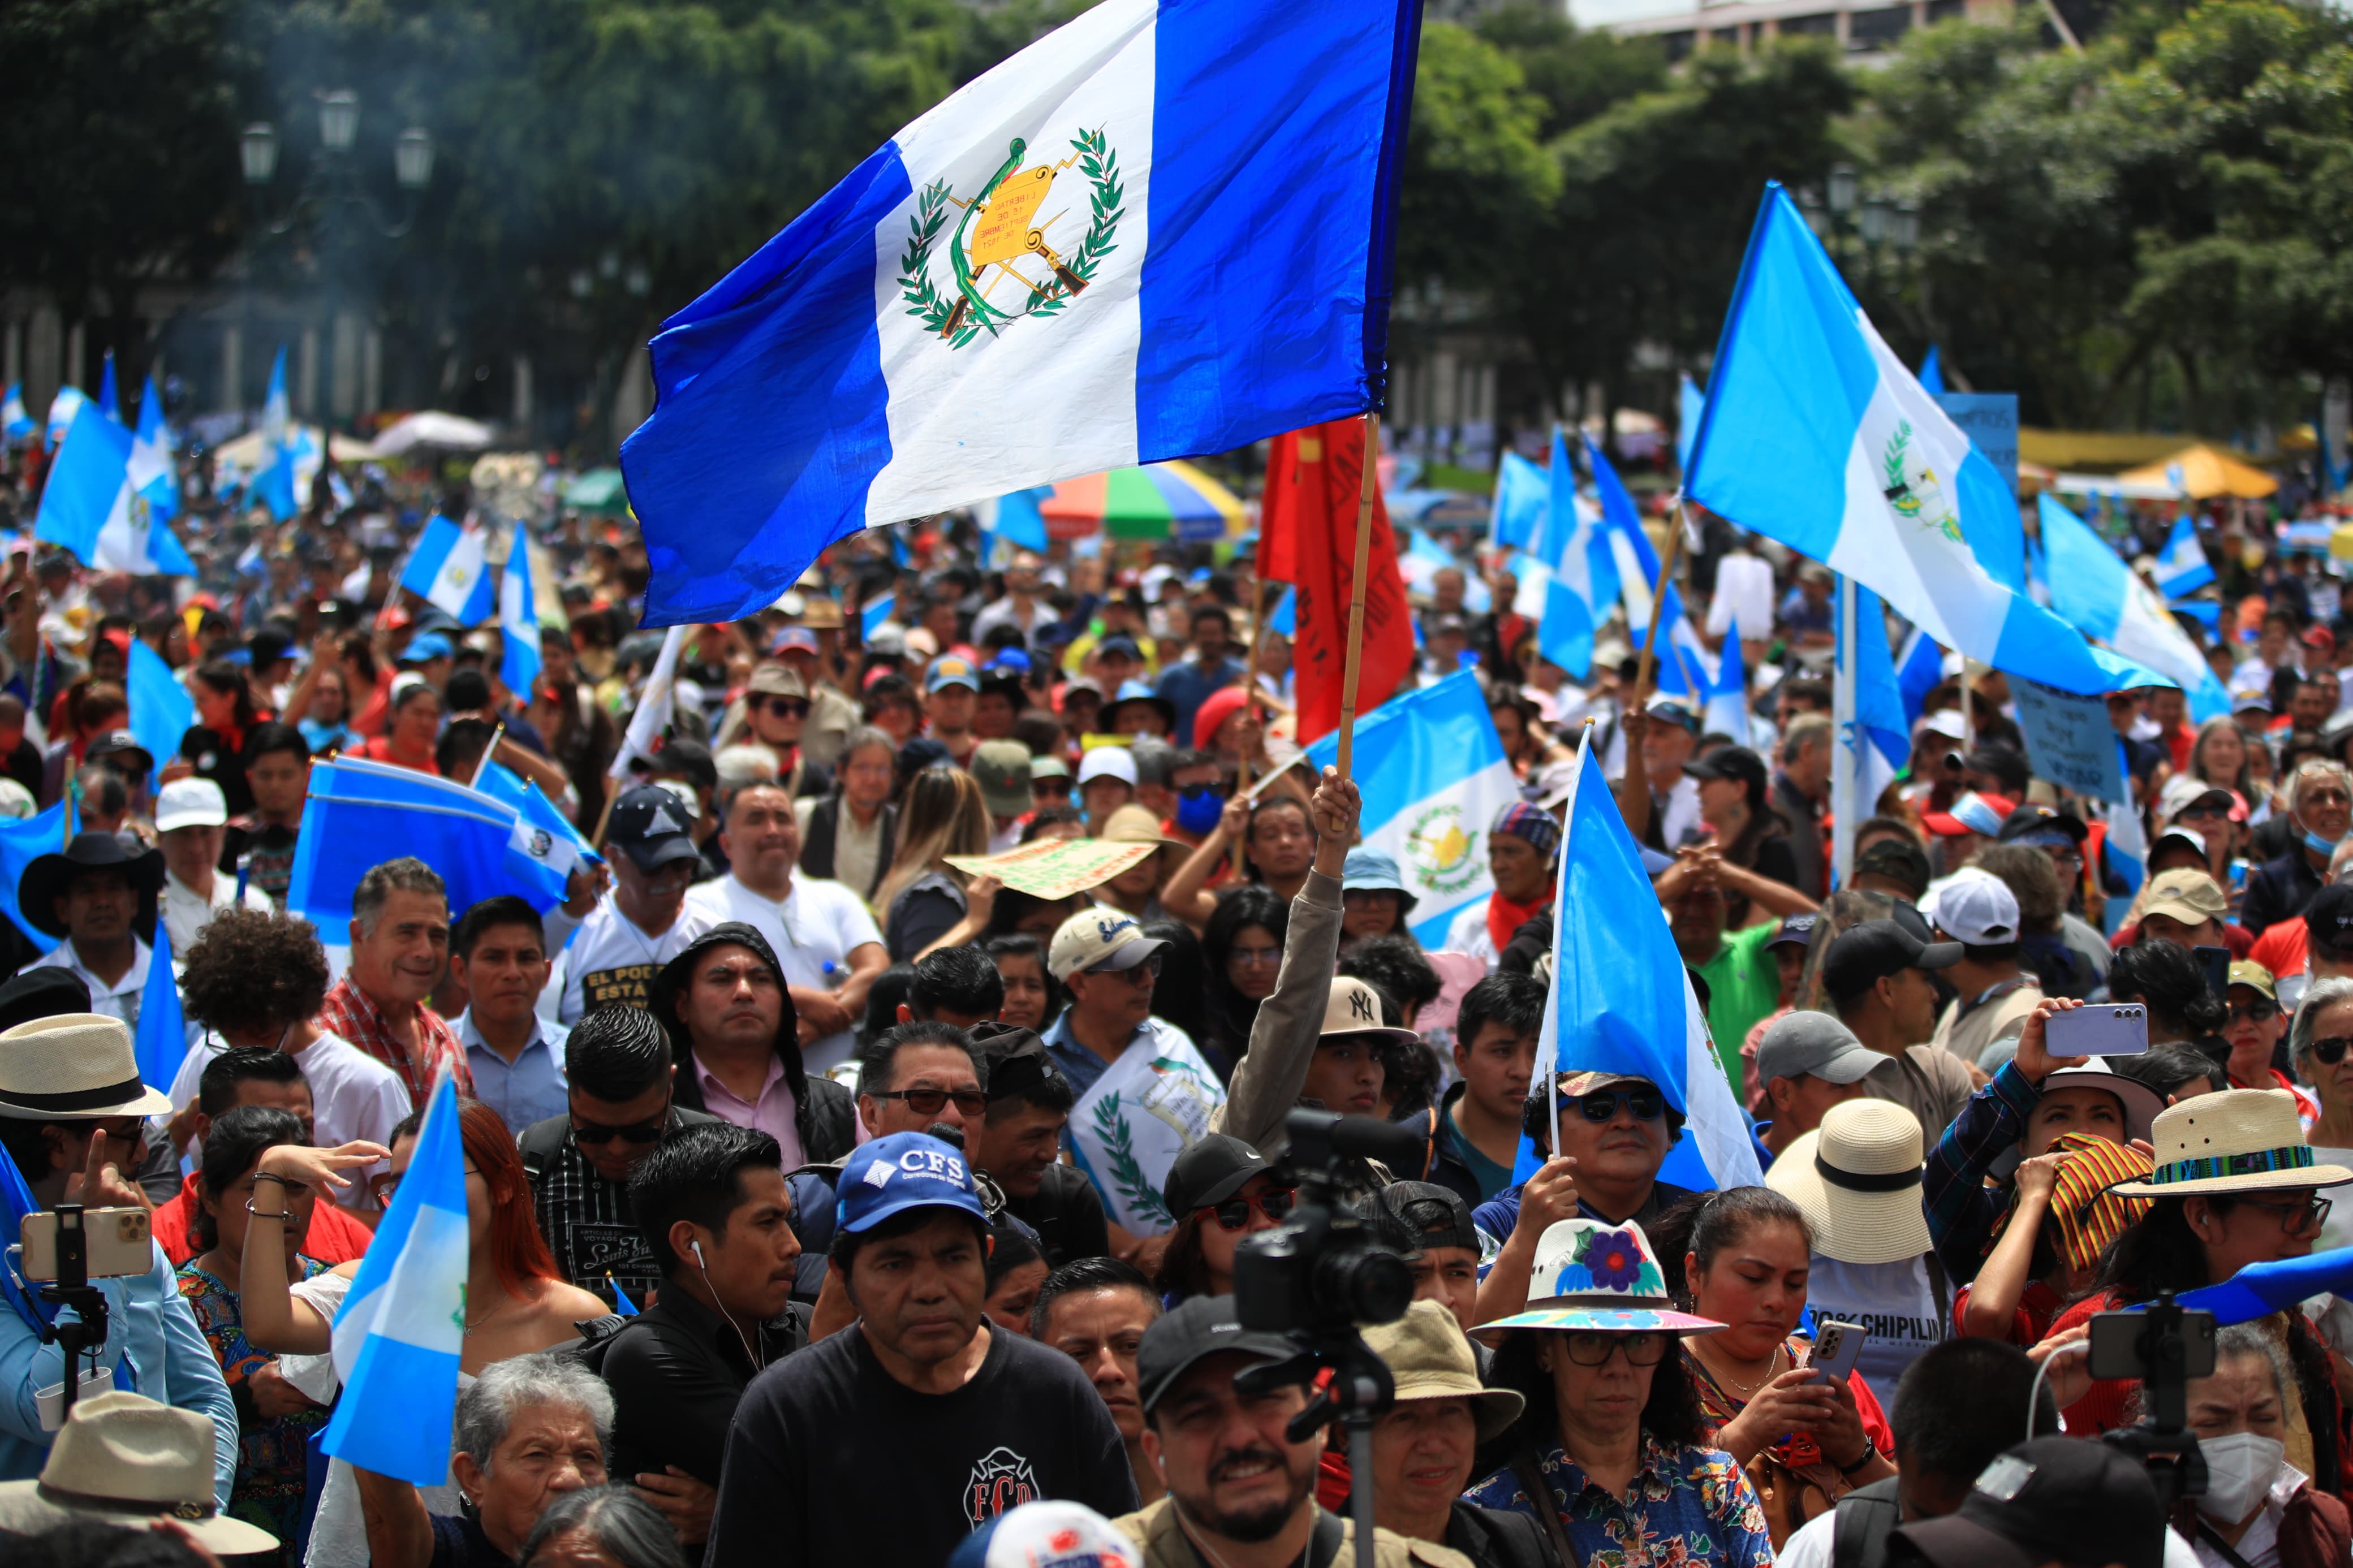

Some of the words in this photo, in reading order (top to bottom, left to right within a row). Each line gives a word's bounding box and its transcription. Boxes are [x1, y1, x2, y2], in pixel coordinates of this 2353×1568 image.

[587, 972, 610, 987] EL
[615, 965, 665, 982] POD
[596, 980, 647, 1001] ESTÁ
[899, 1149, 964, 1181] CFS
[583, 1243, 629, 1269] Louis
